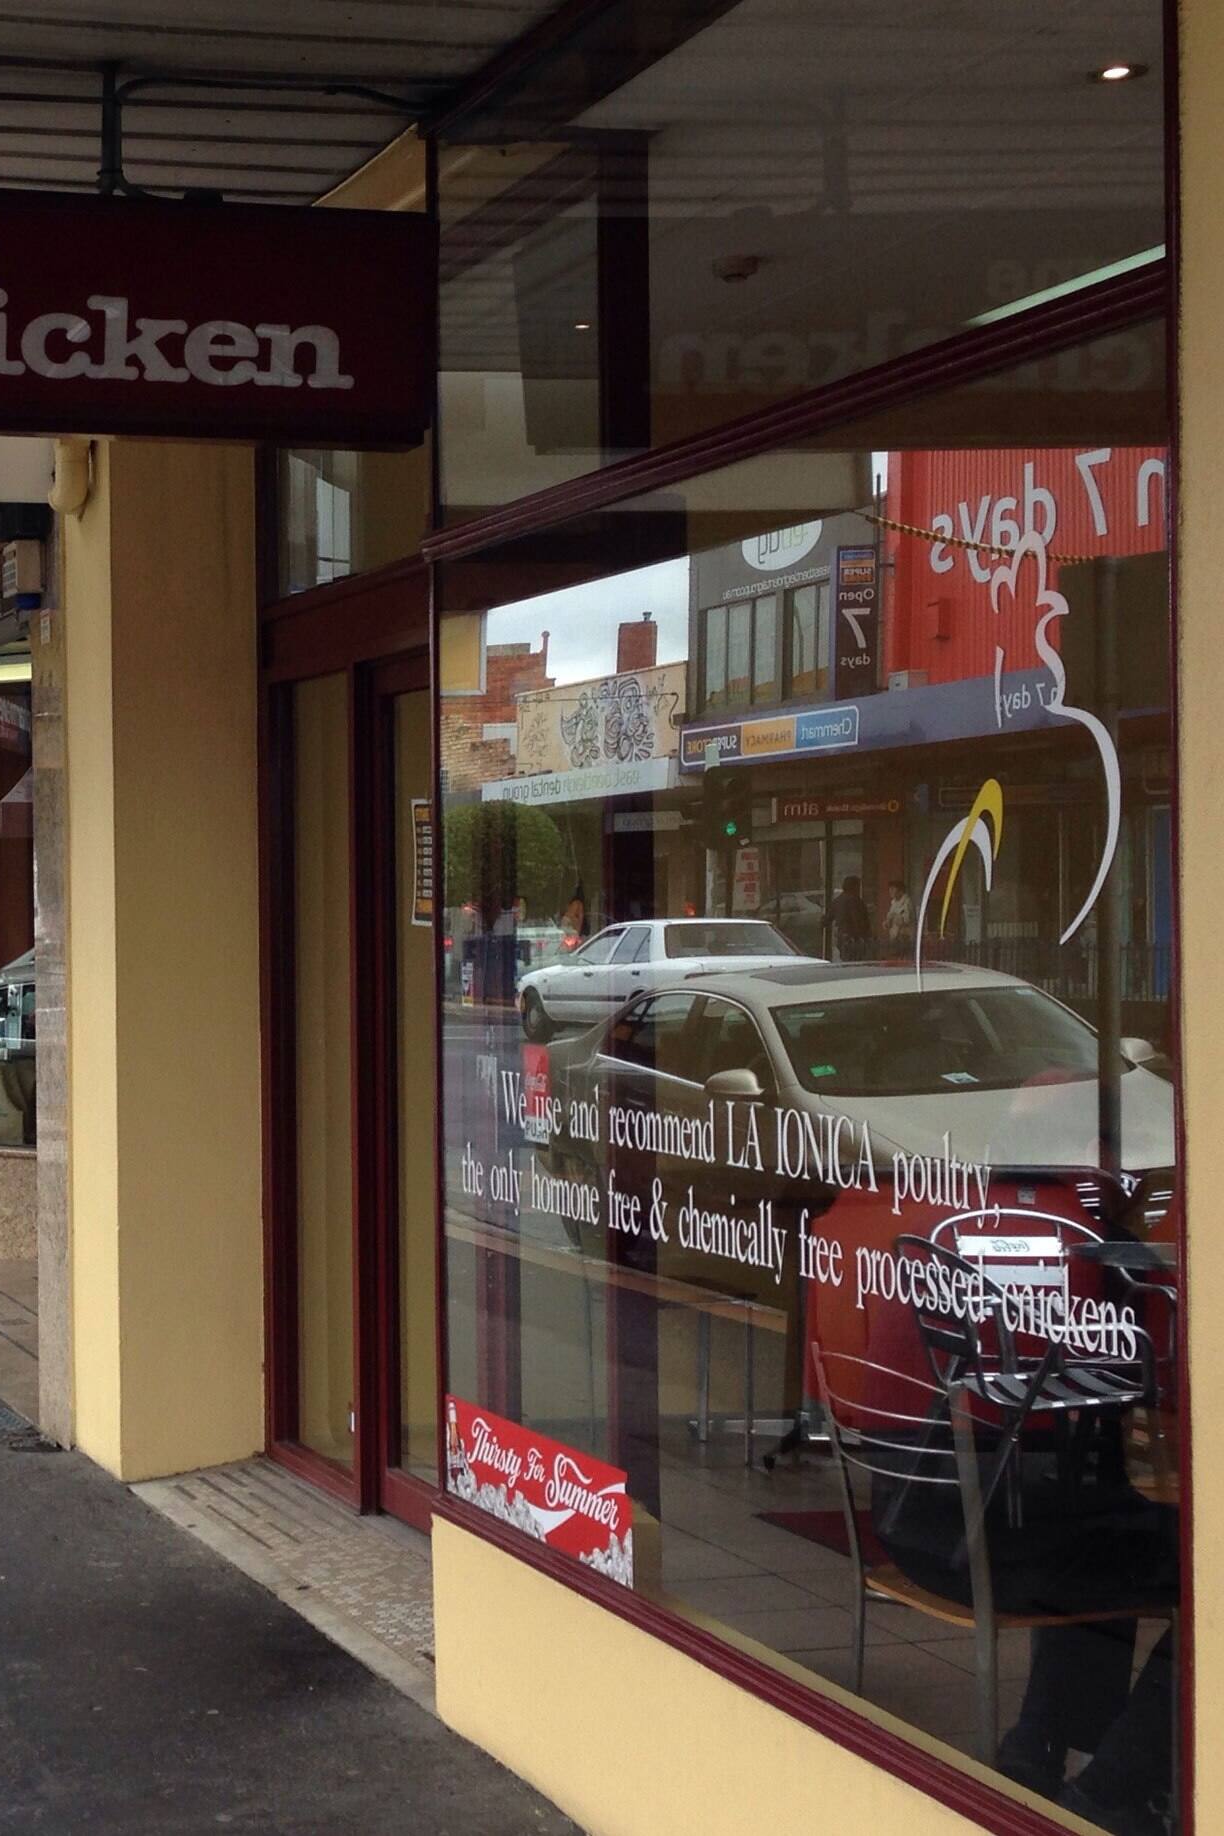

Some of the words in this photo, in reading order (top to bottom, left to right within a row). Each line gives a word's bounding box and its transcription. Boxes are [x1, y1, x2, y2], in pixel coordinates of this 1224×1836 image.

[501, 1070, 527, 1129] We
[534, 1095, 563, 1135] use
[569, 1084, 600, 1142] and
[609, 1099, 716, 1164] recommend
[726, 1100, 764, 1172] LA
[774, 1106, 879, 1193] IONICA
[891, 1130, 1001, 1230] poultry,
[461, 1142, 483, 1197] the
[490, 1148, 521, 1216] only
[530, 1155, 600, 1226] hormone
[608, 1168, 641, 1236] free
[649, 1176, 669, 1242] &
[678, 1185, 788, 1285] chemically
[798, 1208, 843, 1287] free
[856, 1246, 985, 1324] processed
[1001, 1259, 1137, 1362] chickens
[466, 1417, 522, 1488] Thirsty
[524, 1447, 546, 1482] For
[545, 1453, 620, 1531] Summer
